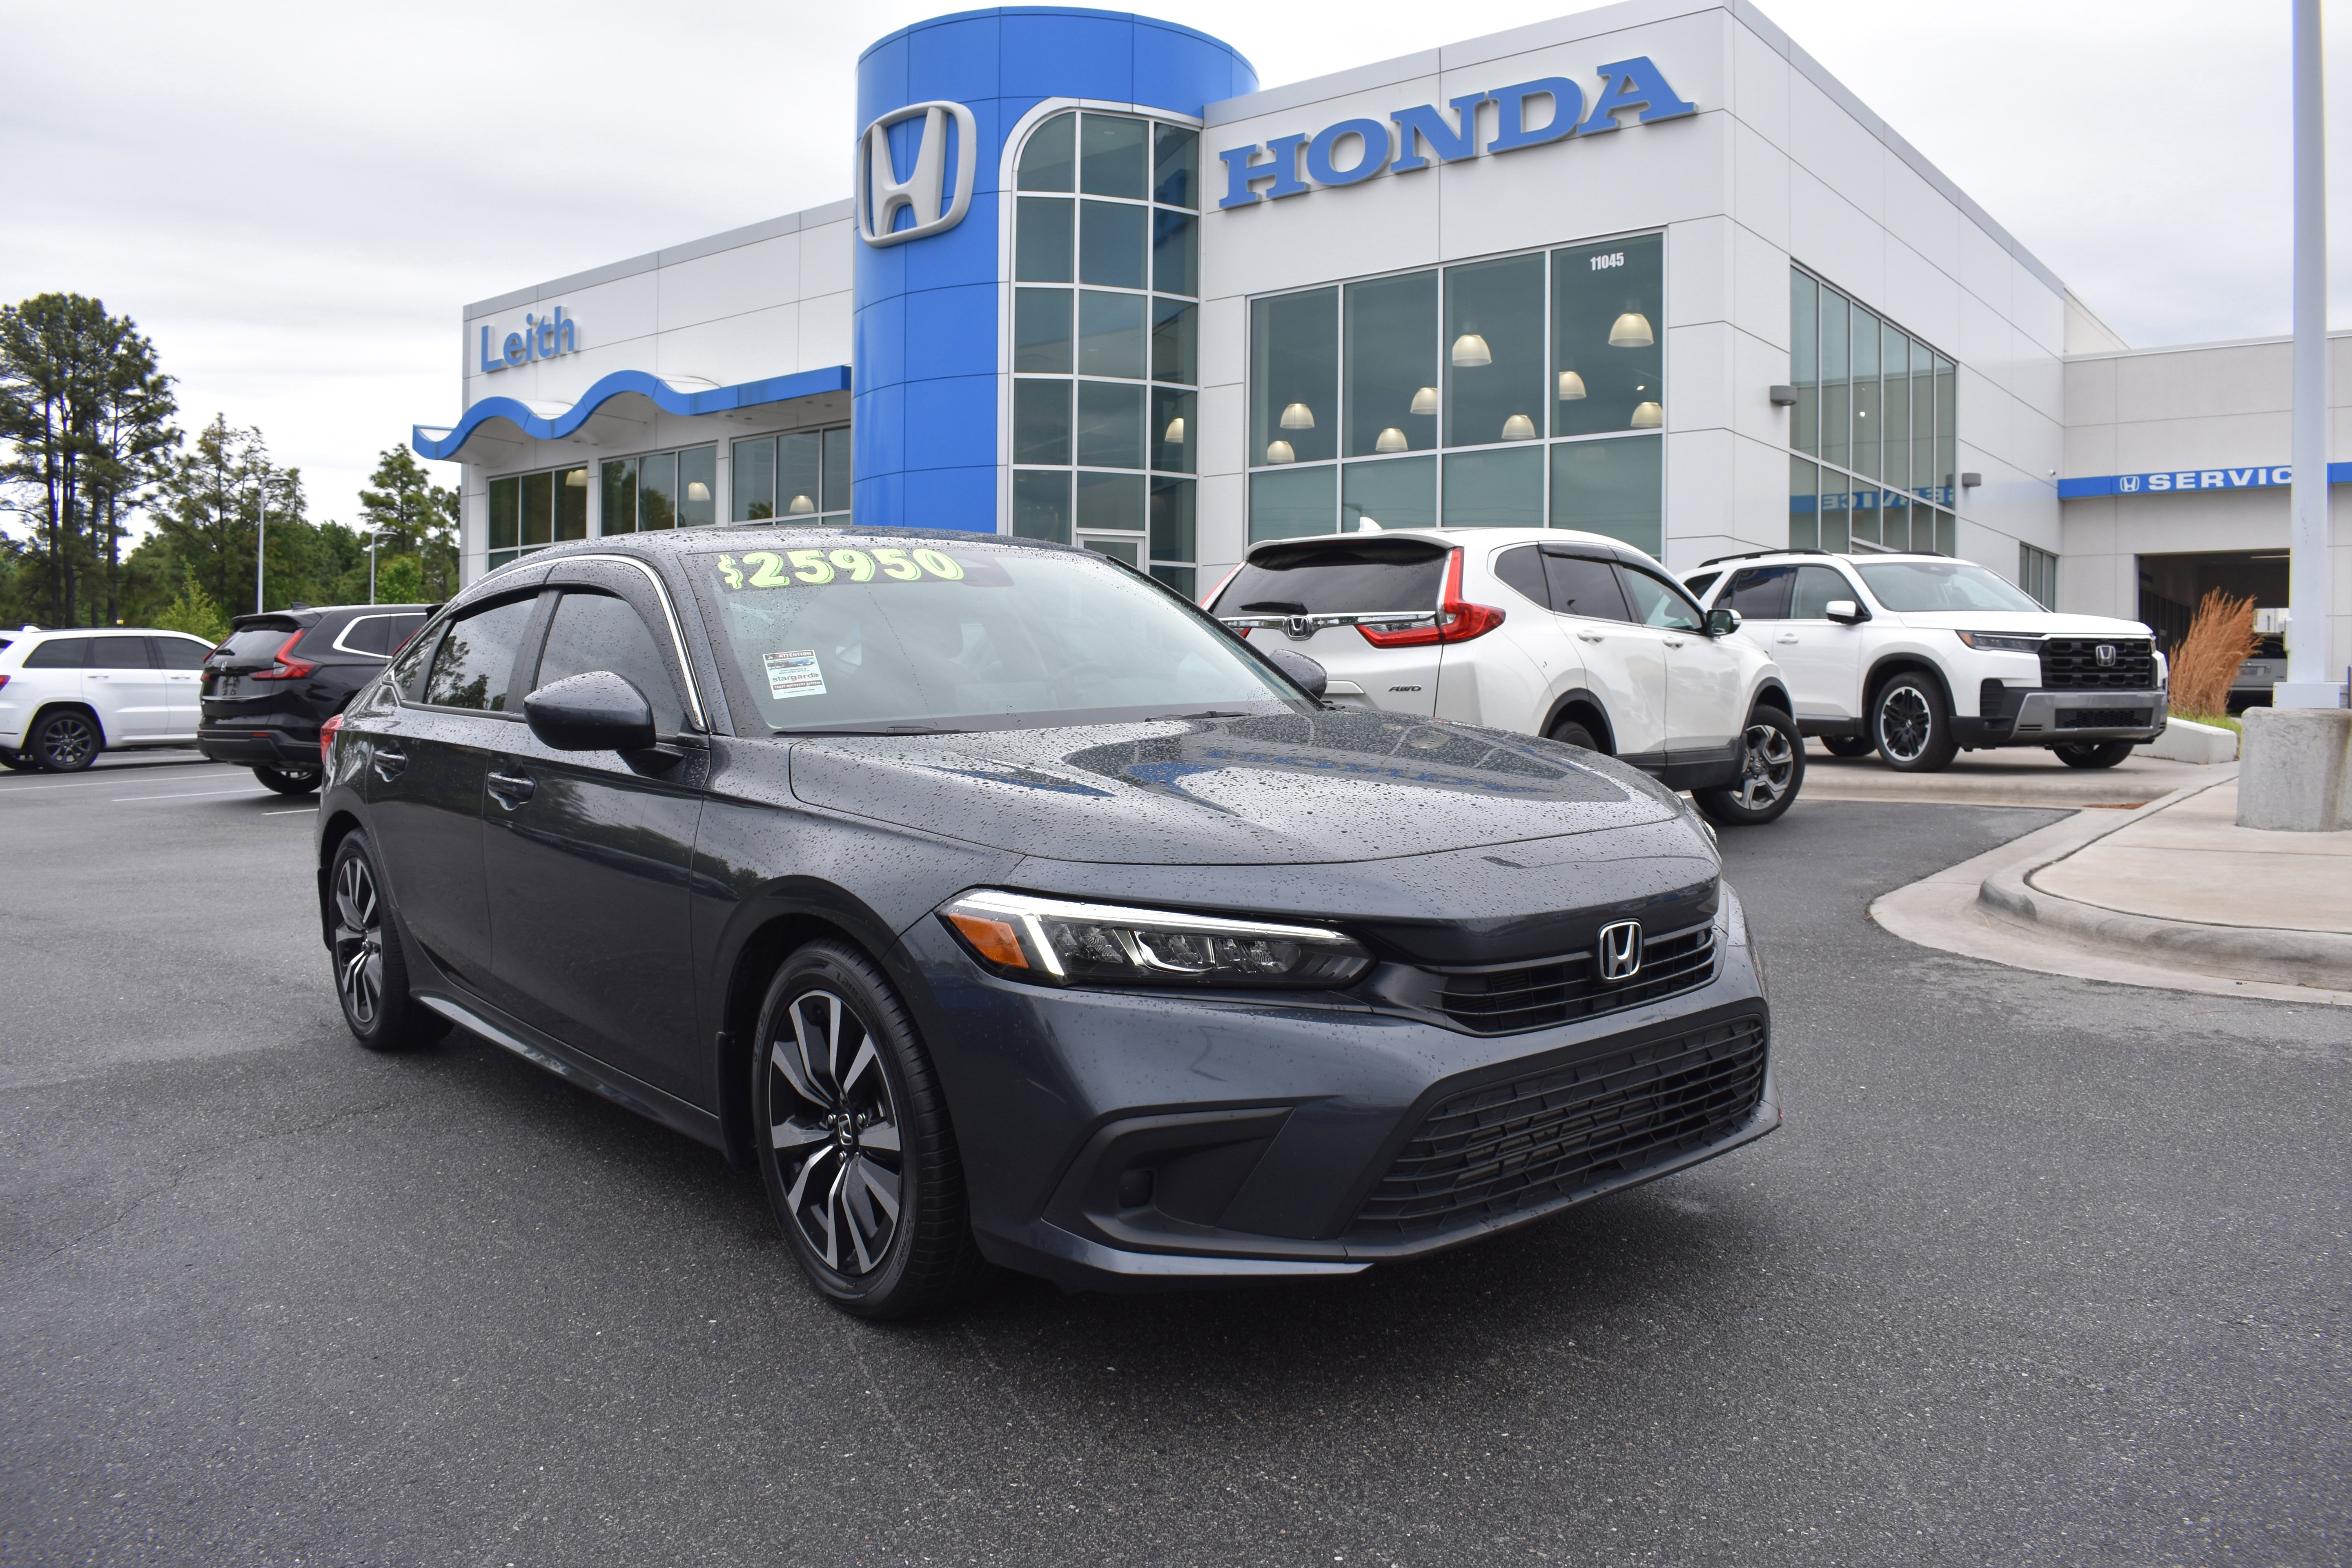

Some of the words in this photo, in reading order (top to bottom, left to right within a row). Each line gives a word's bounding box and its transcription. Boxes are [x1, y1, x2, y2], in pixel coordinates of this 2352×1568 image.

[1218, 56, 1698, 209] HONDA
[1590, 252, 1625, 271] 11045
[481, 305, 577, 372] Leith
[2148, 467, 2292, 490] SERVIC
[717, 548, 964, 590] $25950
[773, 673, 813, 682] stargard
